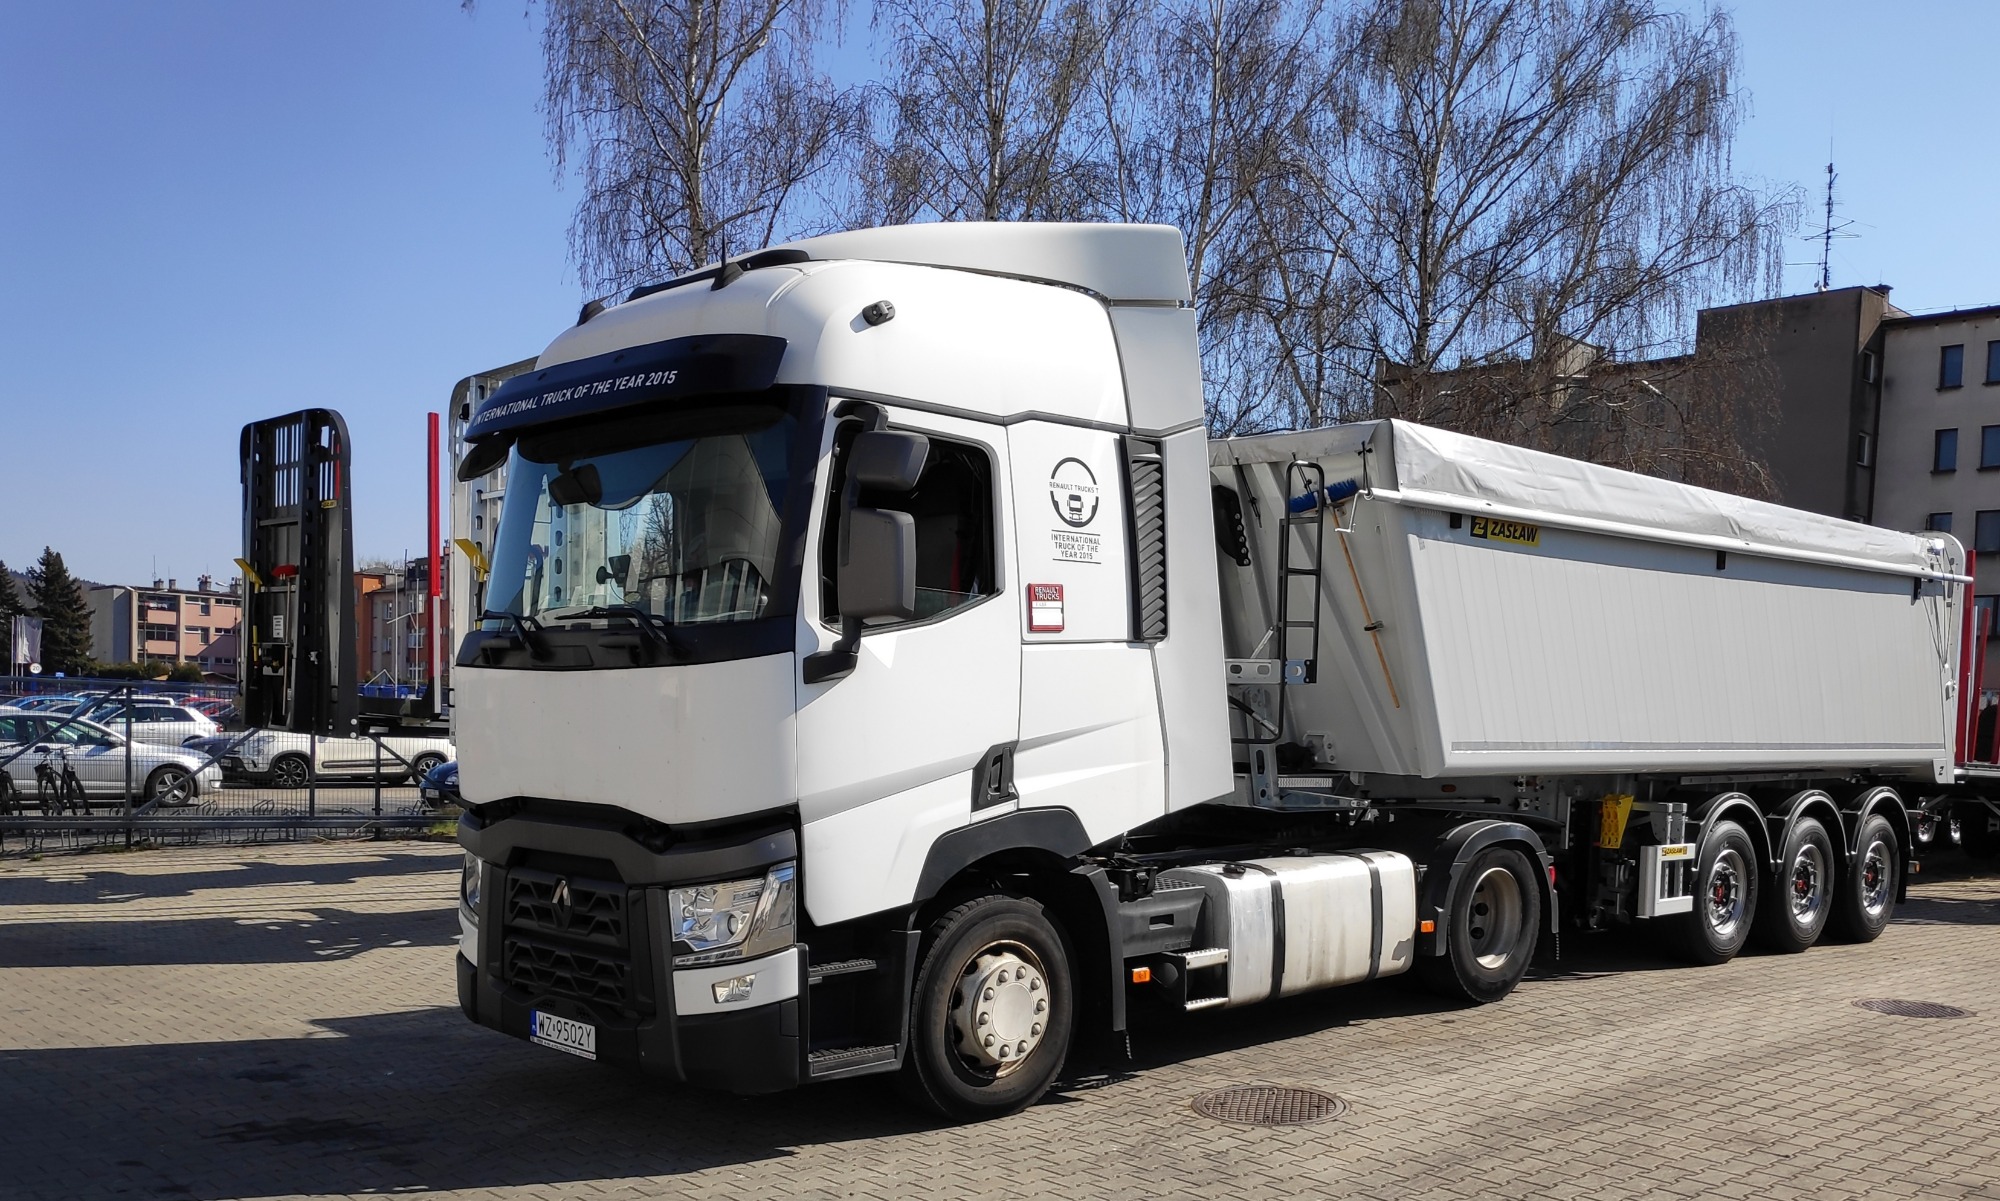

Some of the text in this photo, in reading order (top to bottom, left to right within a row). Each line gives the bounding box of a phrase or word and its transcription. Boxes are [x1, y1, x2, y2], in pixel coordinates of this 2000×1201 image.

[473, 370, 678, 426] INTERNATIONAL TRUCK OF THE YEAR 2015
[1049, 481, 1073, 491] RENAULT
[1074, 484, 1095, 493] TRUCKS
[1051, 533, 1101, 545] INTERNATIONAL
[1054, 541, 1099, 553] TRUCK OF THE
[1060, 550, 1093, 560] YEAR 2015
[1034, 586, 1060, 594] RENAULT
[1036, 593, 1060, 601] TRUCKS
